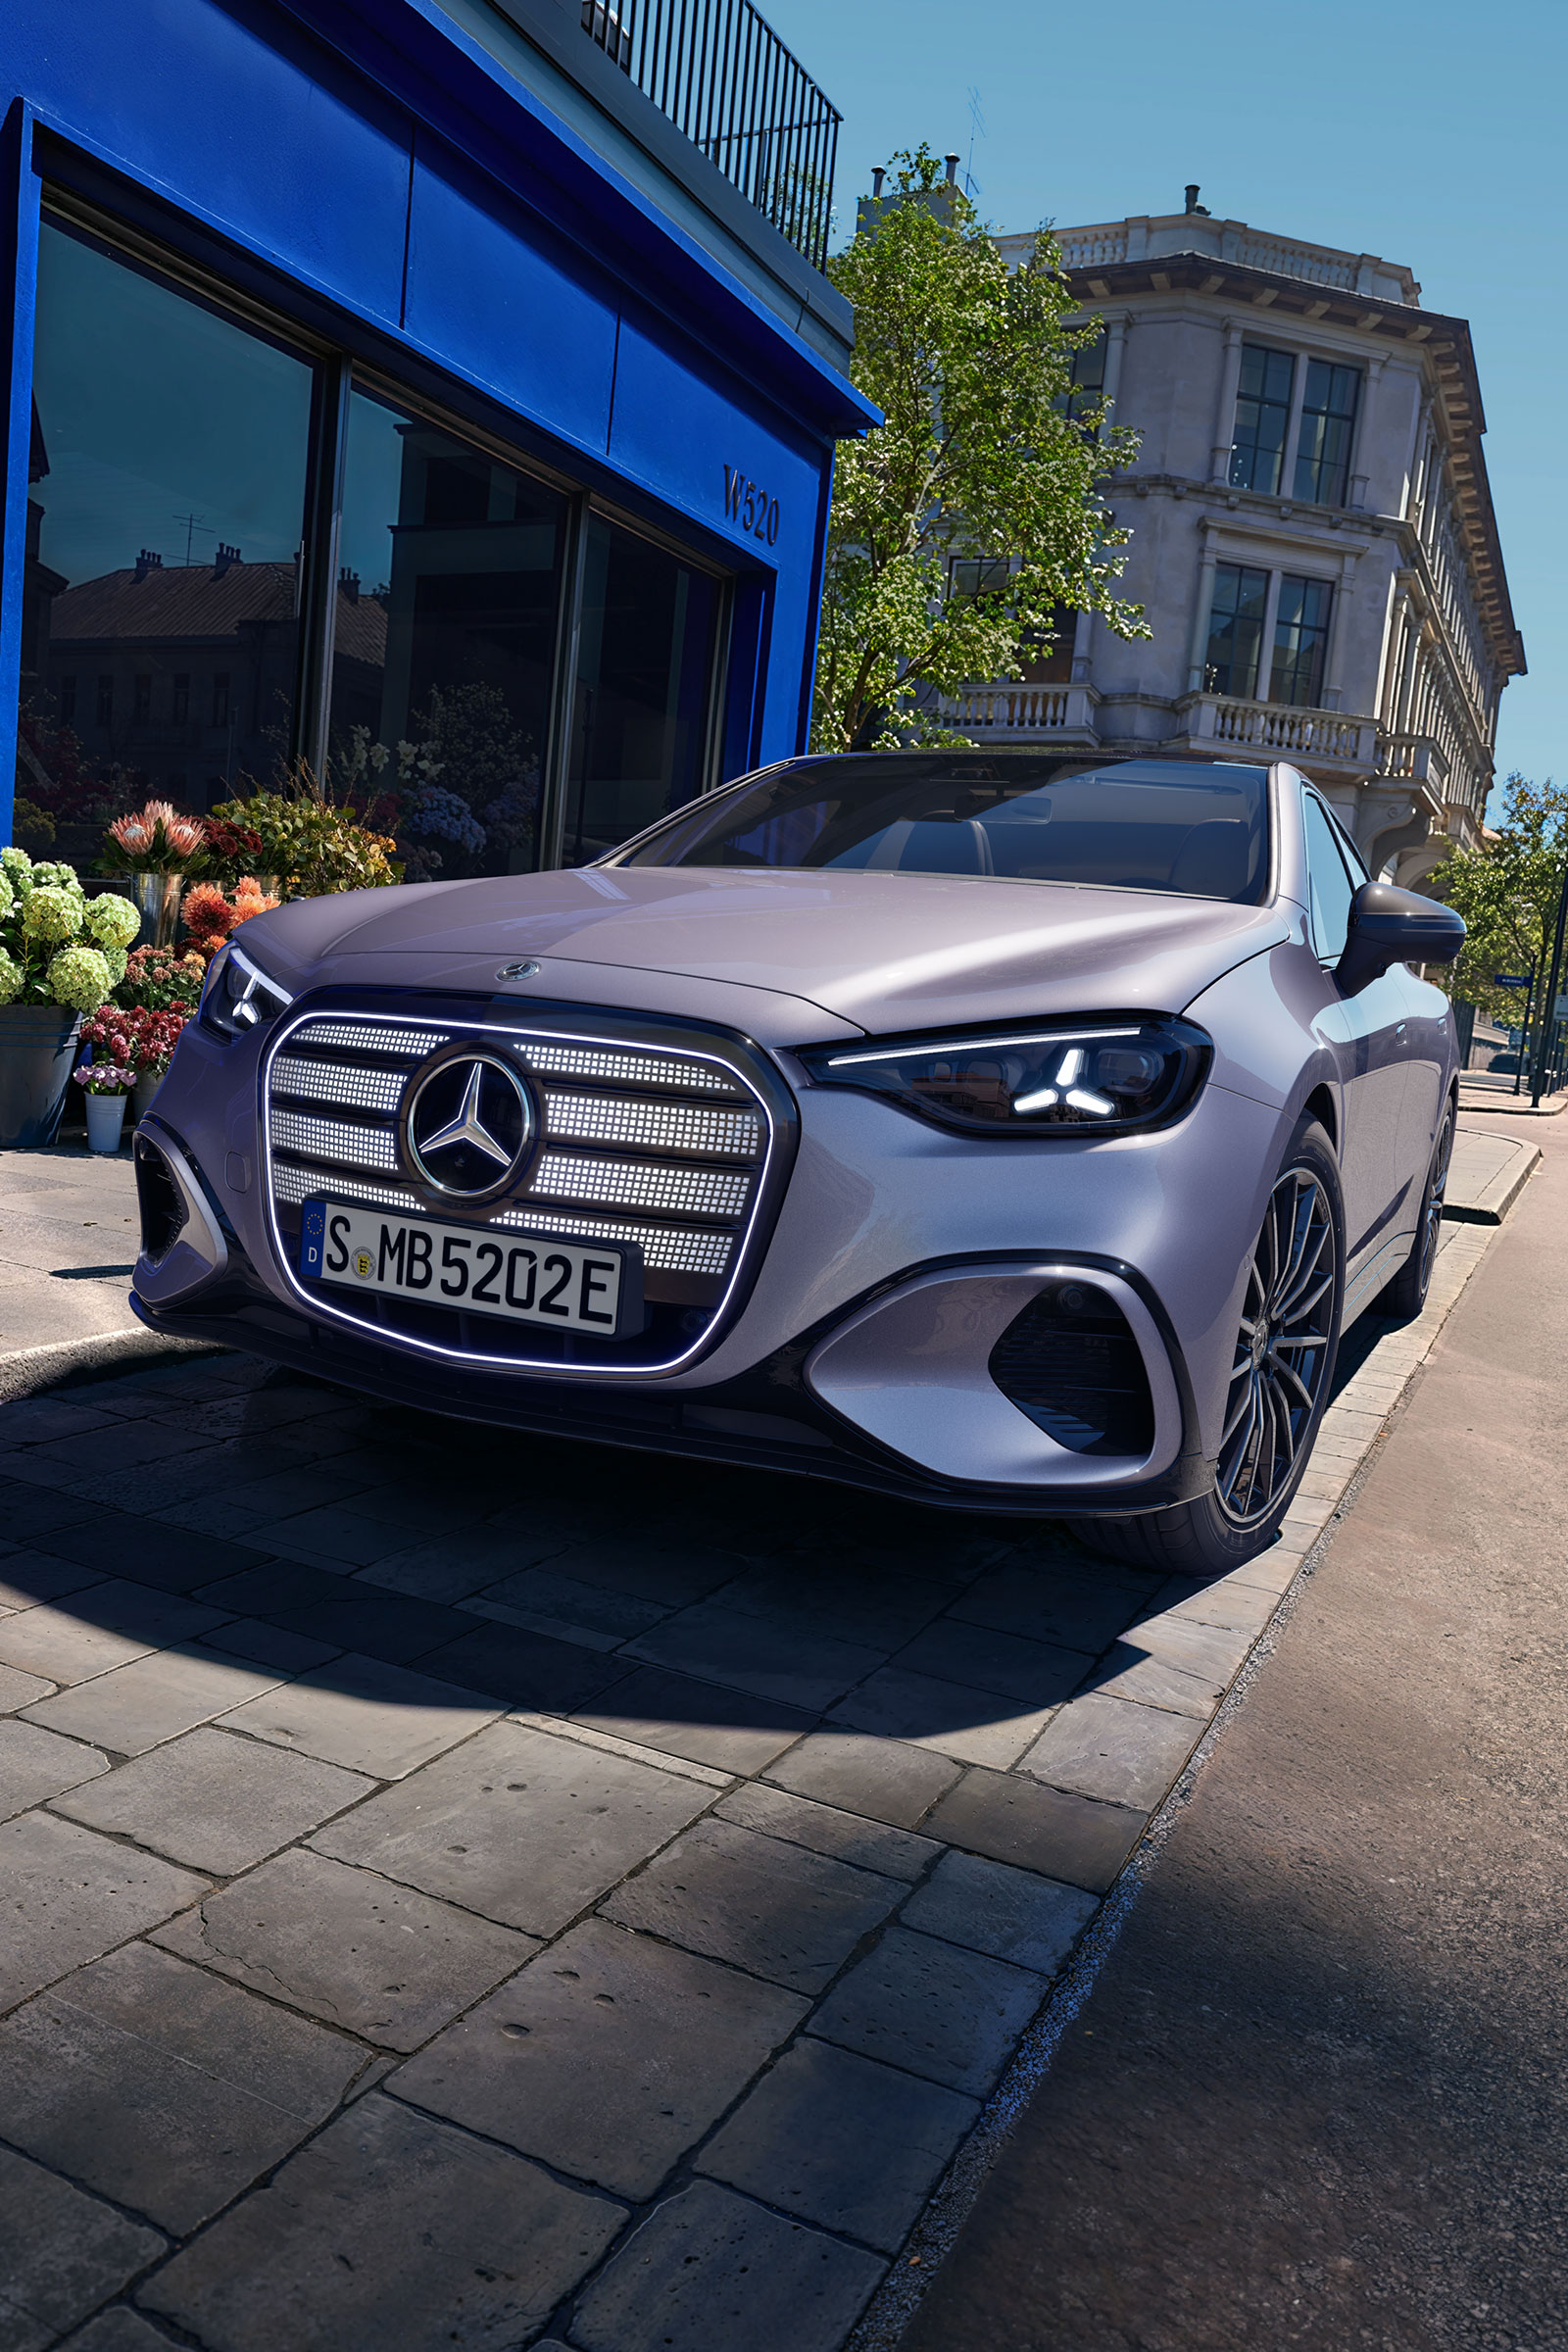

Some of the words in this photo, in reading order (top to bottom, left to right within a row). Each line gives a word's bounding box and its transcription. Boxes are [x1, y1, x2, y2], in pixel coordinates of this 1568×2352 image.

[723, 464, 779, 547] W520
[308, 1247, 318, 1262] D
[326, 1214, 351, 1272] S
